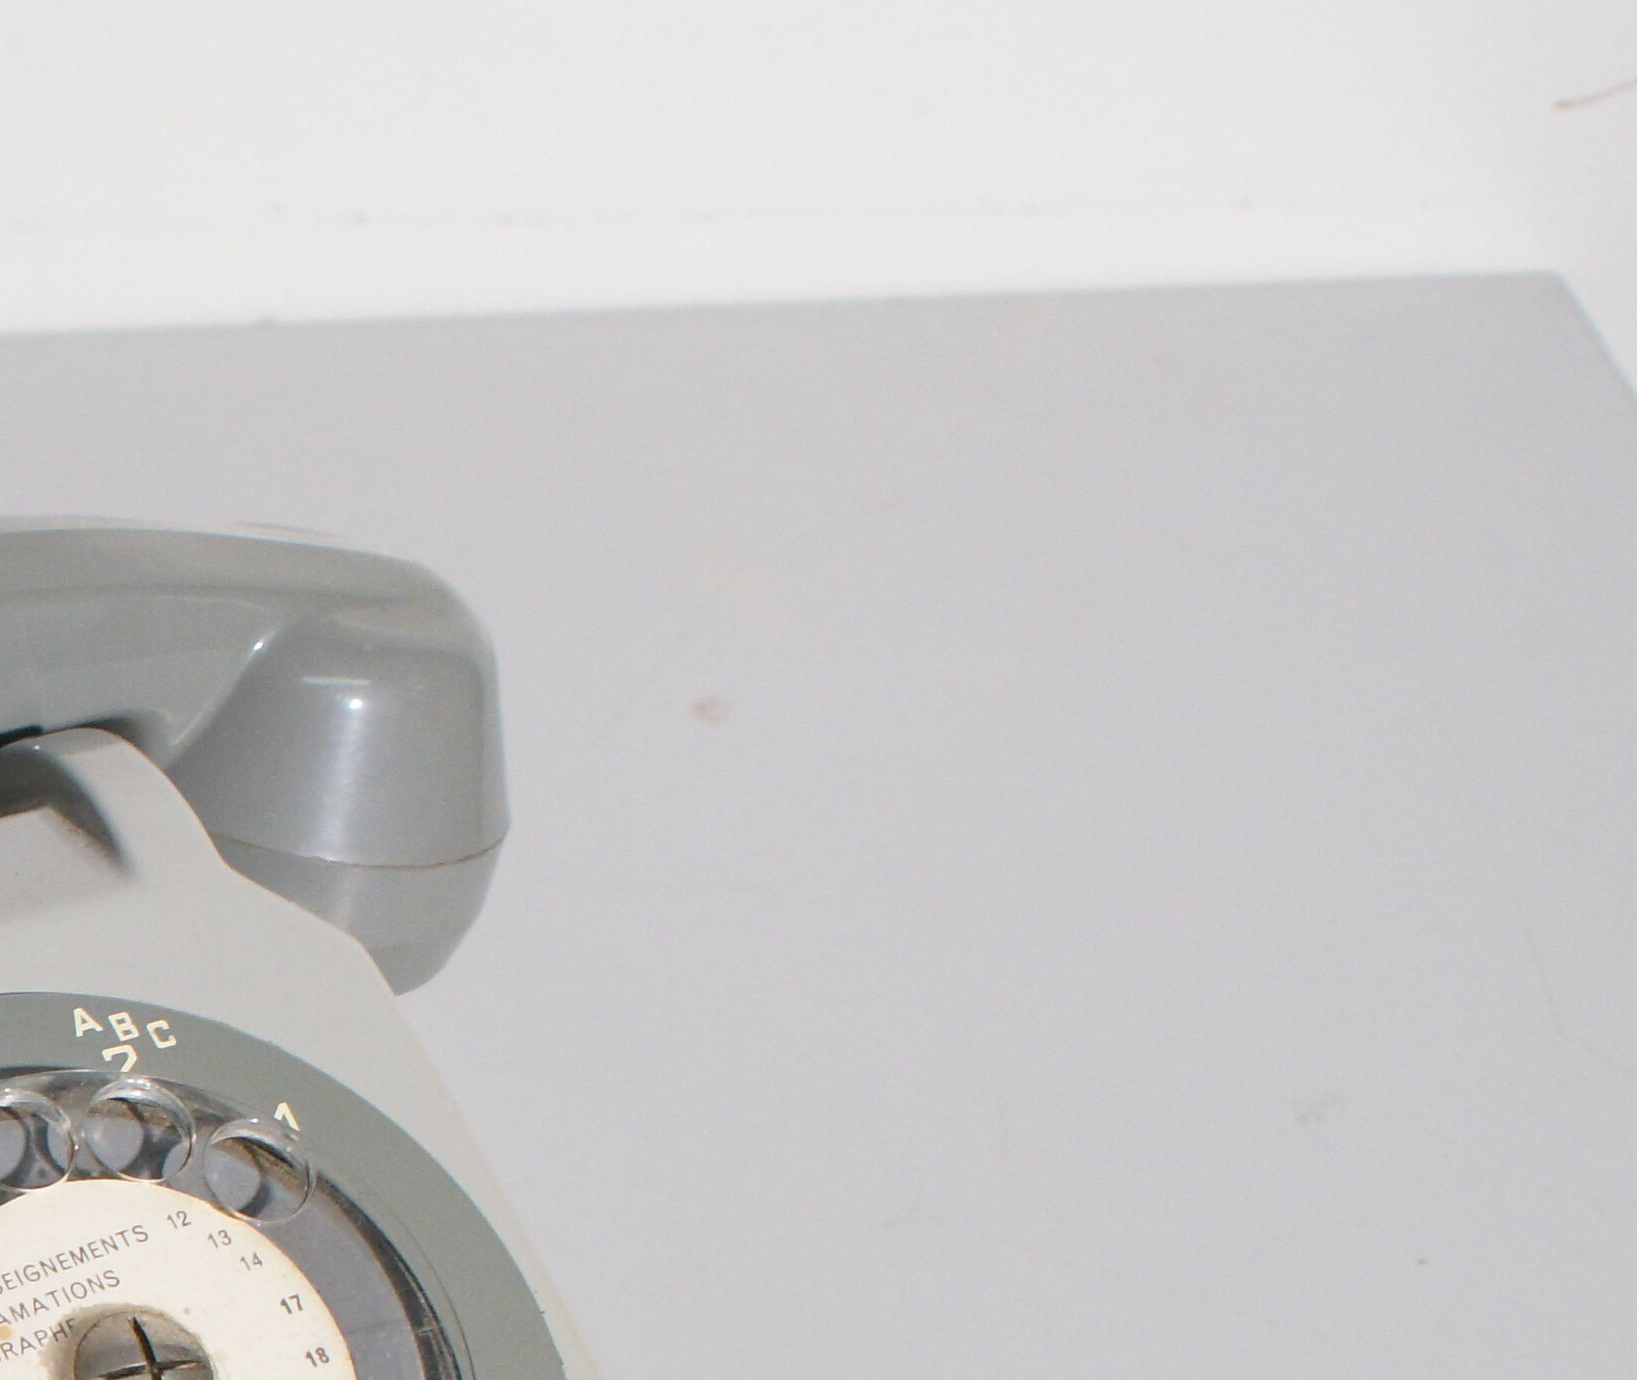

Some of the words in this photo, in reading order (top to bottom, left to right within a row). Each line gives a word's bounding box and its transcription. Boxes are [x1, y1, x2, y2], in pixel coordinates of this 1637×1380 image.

[101, 1045, 138, 1072] 2
[166, 1210, 192, 1230] 12
[207, 1229, 232, 1248] 13
[240, 1251, 263, 1271] 14
[280, 1294, 303, 1315] 17
[305, 1347, 330, 1368] 18
